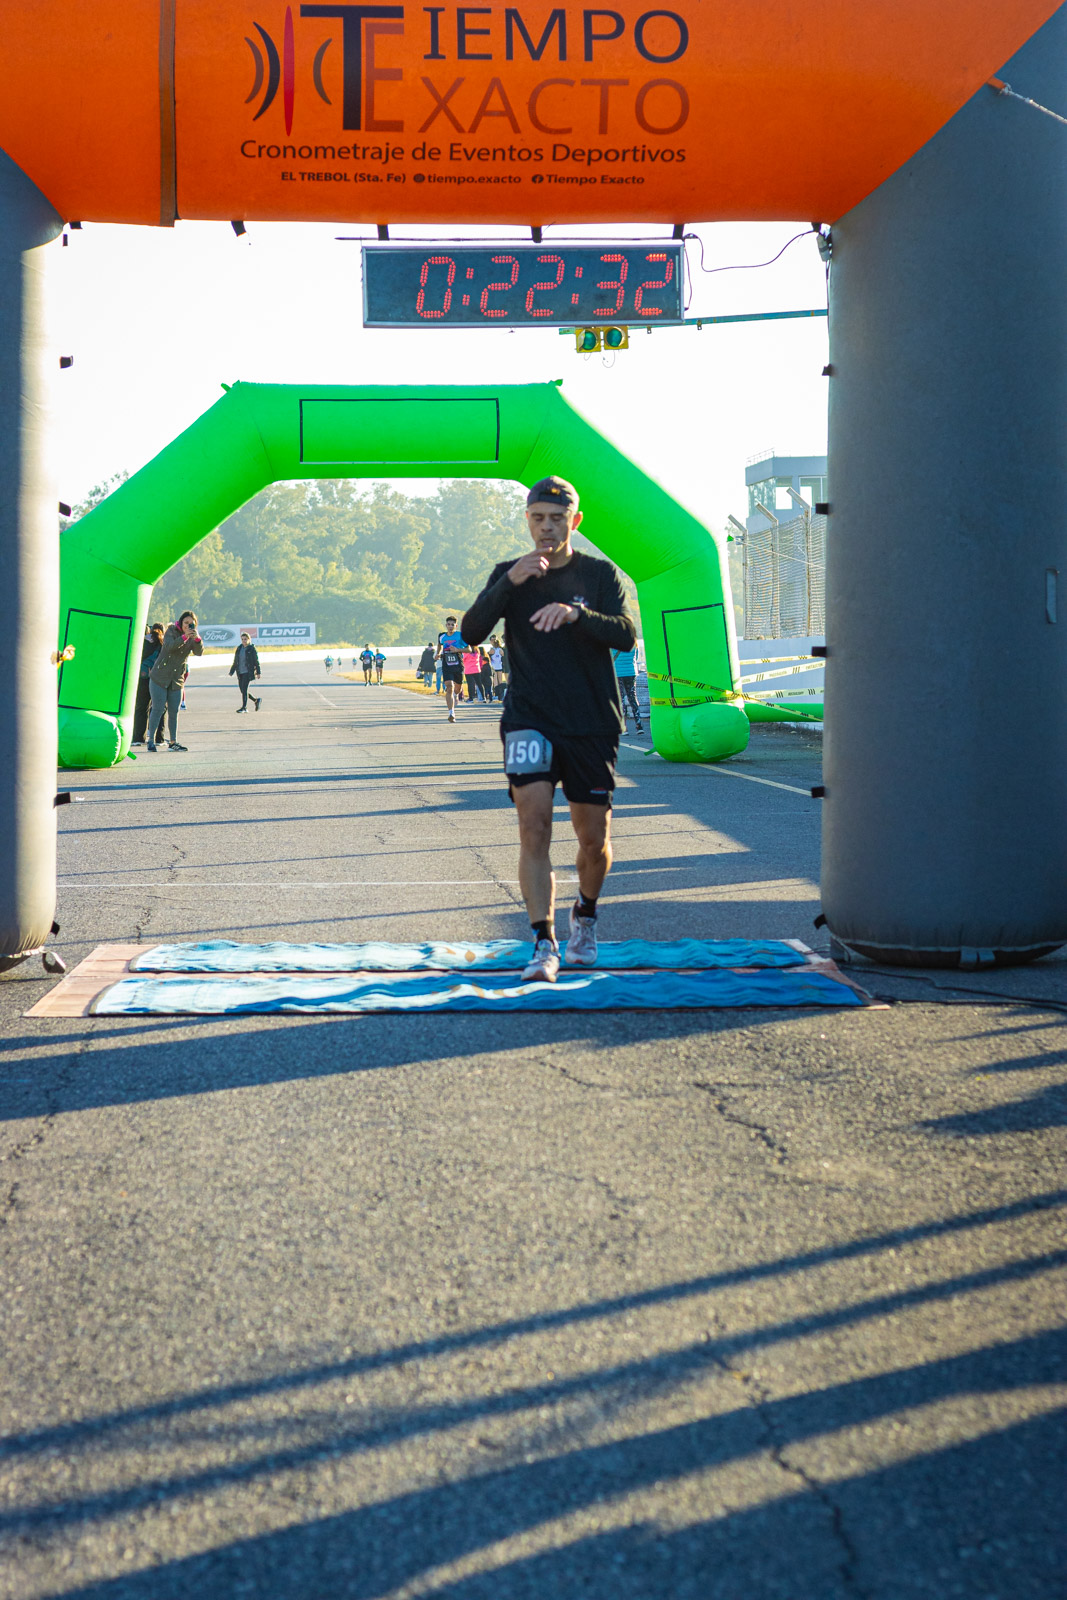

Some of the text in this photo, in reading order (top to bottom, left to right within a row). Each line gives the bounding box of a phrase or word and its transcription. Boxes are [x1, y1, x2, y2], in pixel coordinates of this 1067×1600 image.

[240, 140, 687, 166] Cronometraje de Eventos Deportivos
[281, 171, 406, 183] EL TREBOL (Sta. Fe)
[427, 174, 522, 186] tiempo.exacto
[546, 174, 645, 186] Tiempo Exacto
[416, 254, 674, 319] 0:22:32
[203, 630, 228, 640] Ford
[261, 628, 307, 636] LONG
[507, 740, 540, 764] 150
